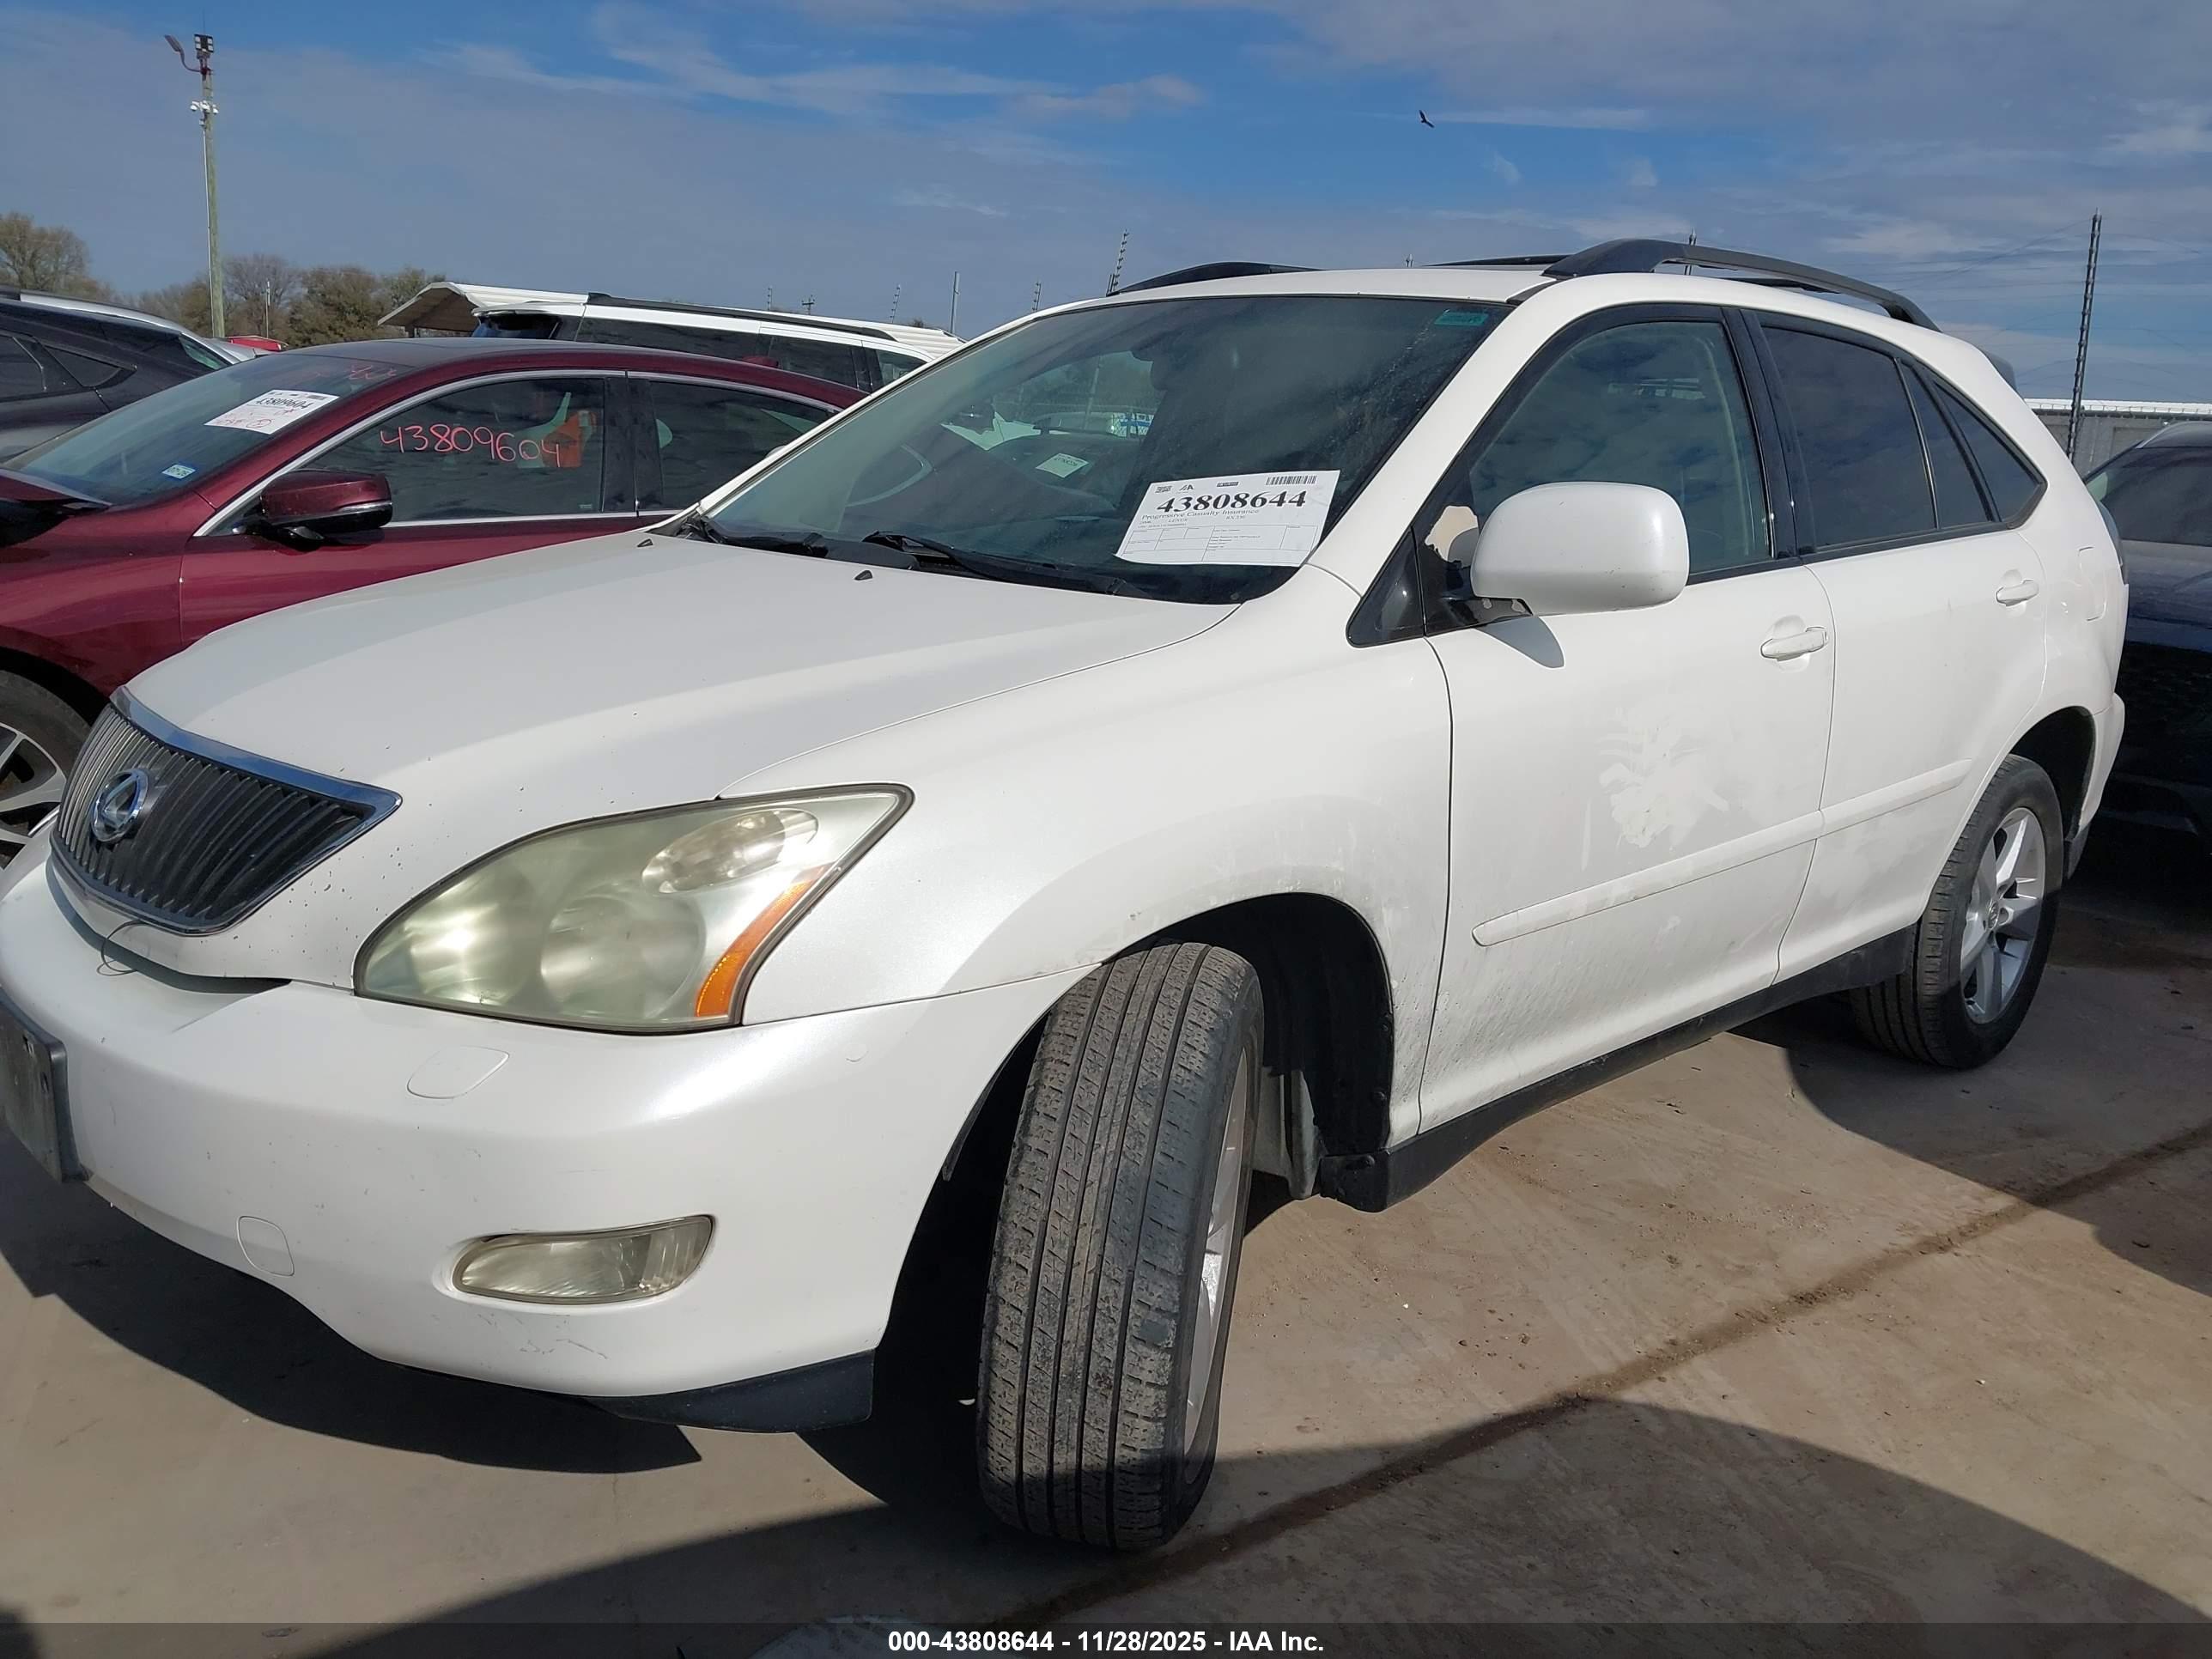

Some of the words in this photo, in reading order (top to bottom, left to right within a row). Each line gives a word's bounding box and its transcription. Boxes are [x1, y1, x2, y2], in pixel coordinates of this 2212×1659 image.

[380, 424, 561, 468] 43809604
[1157, 490, 1307, 513] 43808644
[1141, 512, 1186, 520] Progressive
